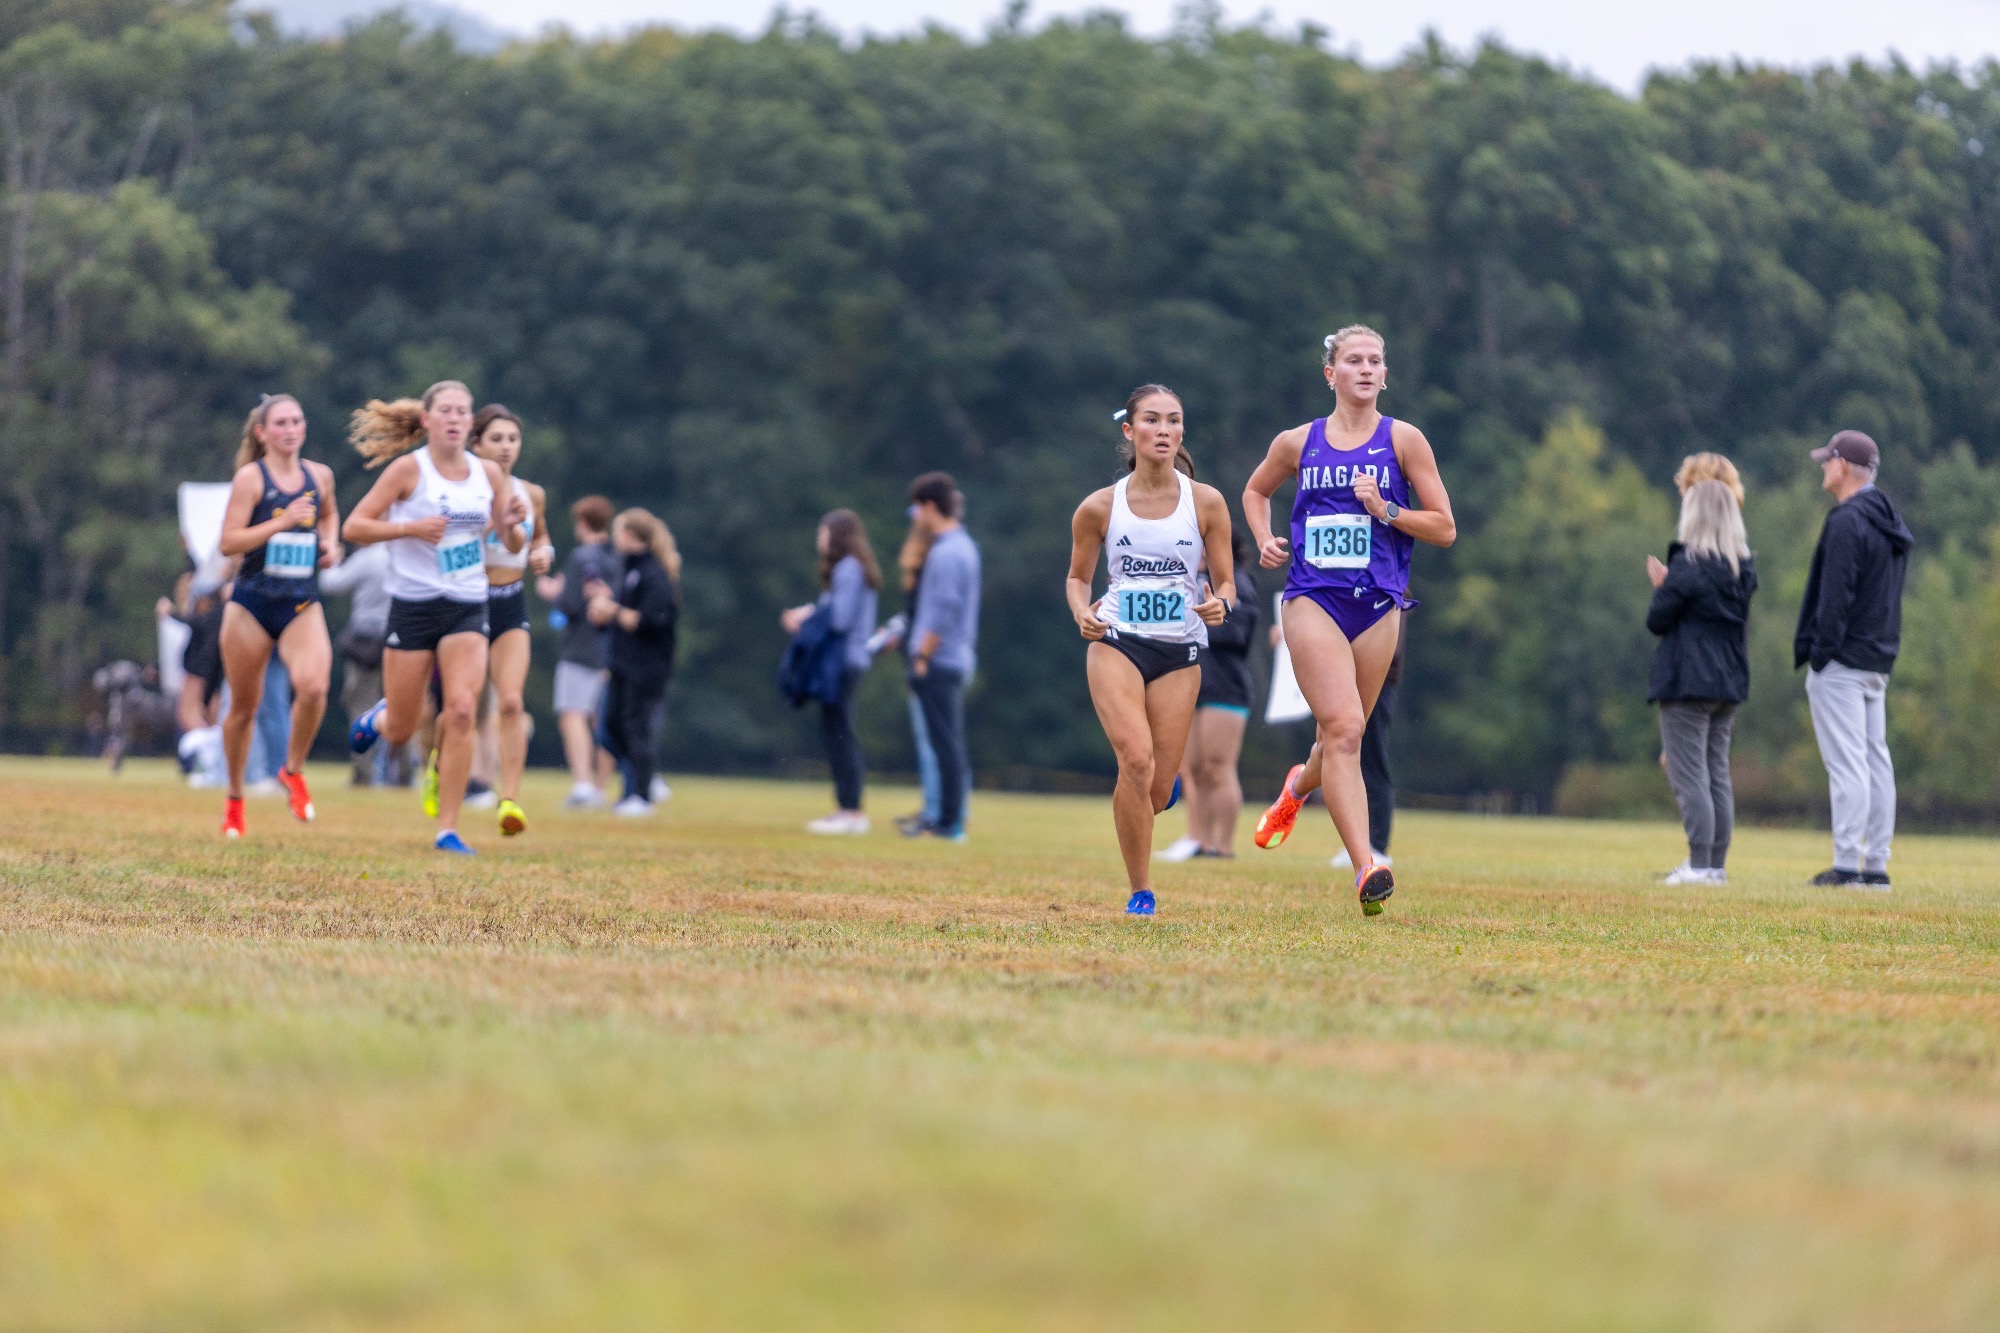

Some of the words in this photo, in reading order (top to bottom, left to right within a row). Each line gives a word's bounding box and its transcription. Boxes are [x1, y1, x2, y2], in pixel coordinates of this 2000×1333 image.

[1301, 464, 1391, 490] NIAGARA
[1312, 527, 1367, 557] 1336
[1121, 555, 1188, 576] Bonnies
[1126, 592, 1182, 621] 1362
[1188, 646, 1198, 661] B
